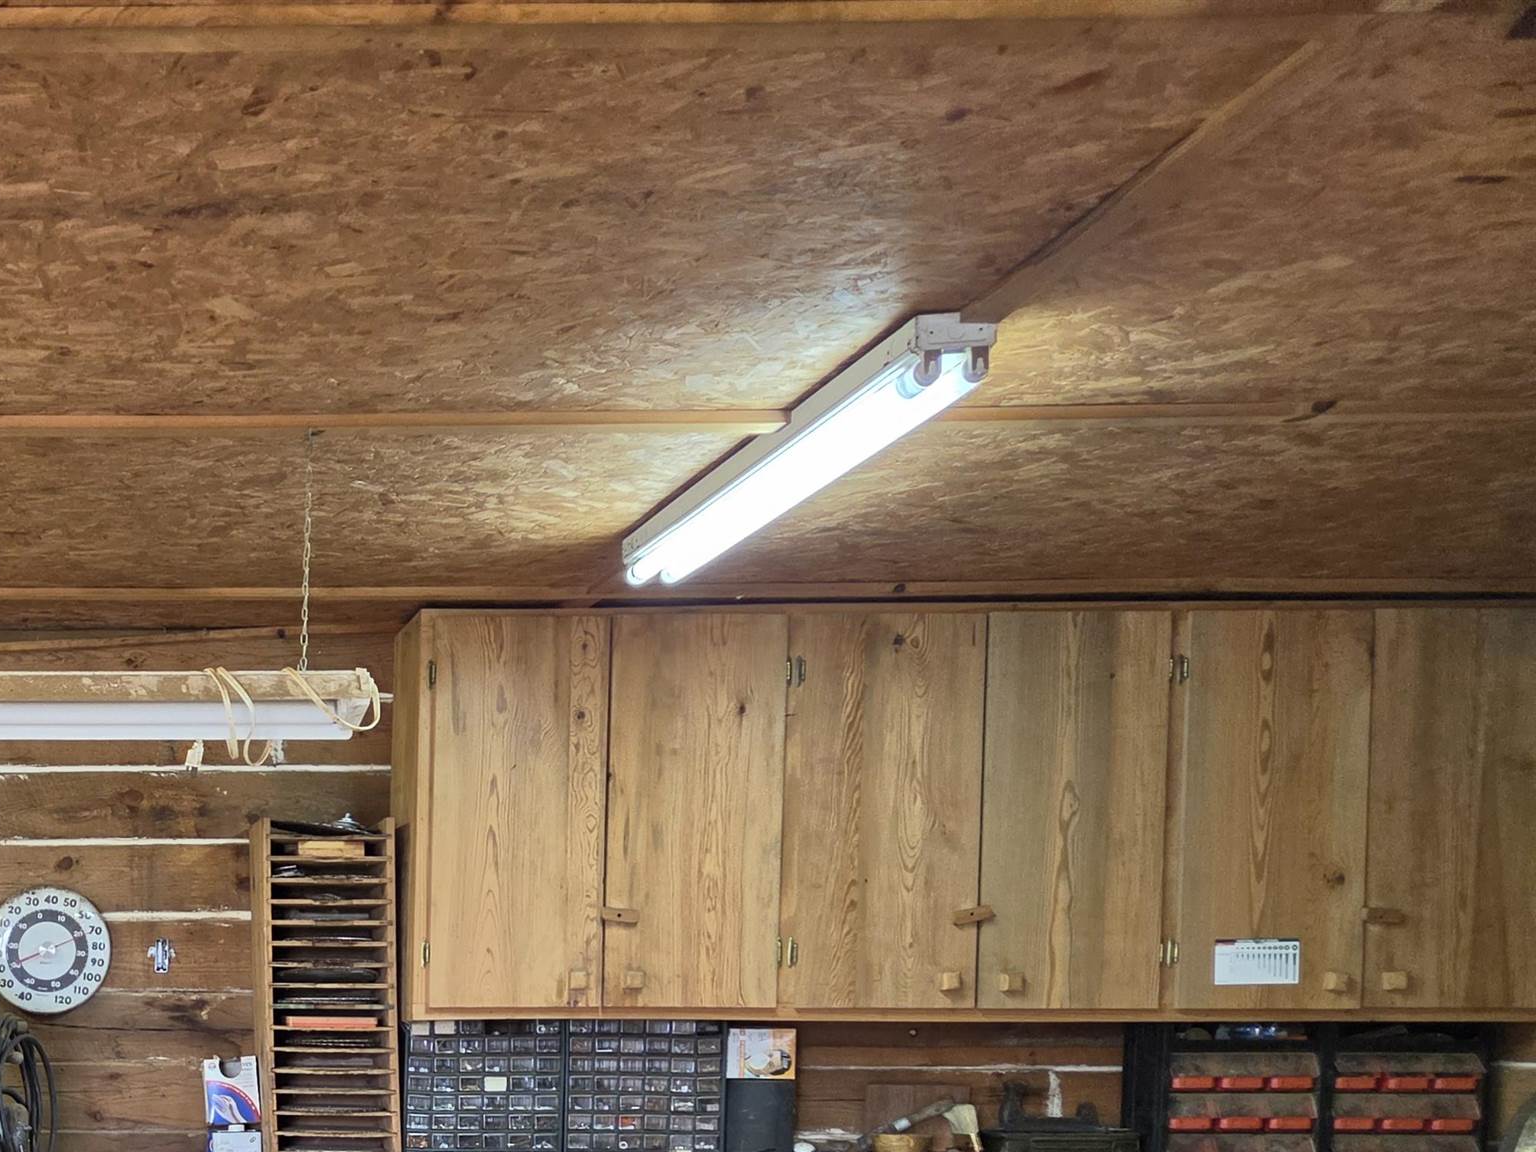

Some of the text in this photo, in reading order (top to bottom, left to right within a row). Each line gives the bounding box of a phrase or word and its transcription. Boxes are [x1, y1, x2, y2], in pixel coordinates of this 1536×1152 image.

[25, 897, 40, 906] 30
[44, 896, 59, 904] 40
[63, 898, 77, 908] 50
[8, 905, 21, 915] 20
[0, 918, 11, 928] 10
[88, 925, 102, 935] 70
[91, 942, 106, 951] 80
[90, 958, 104, 967] 90
[83, 973, 101, 982] 100
[73, 986, 89, 995] 110
[15, 991, 32, 1001] -40
[54, 995, 72, 1005] 120
